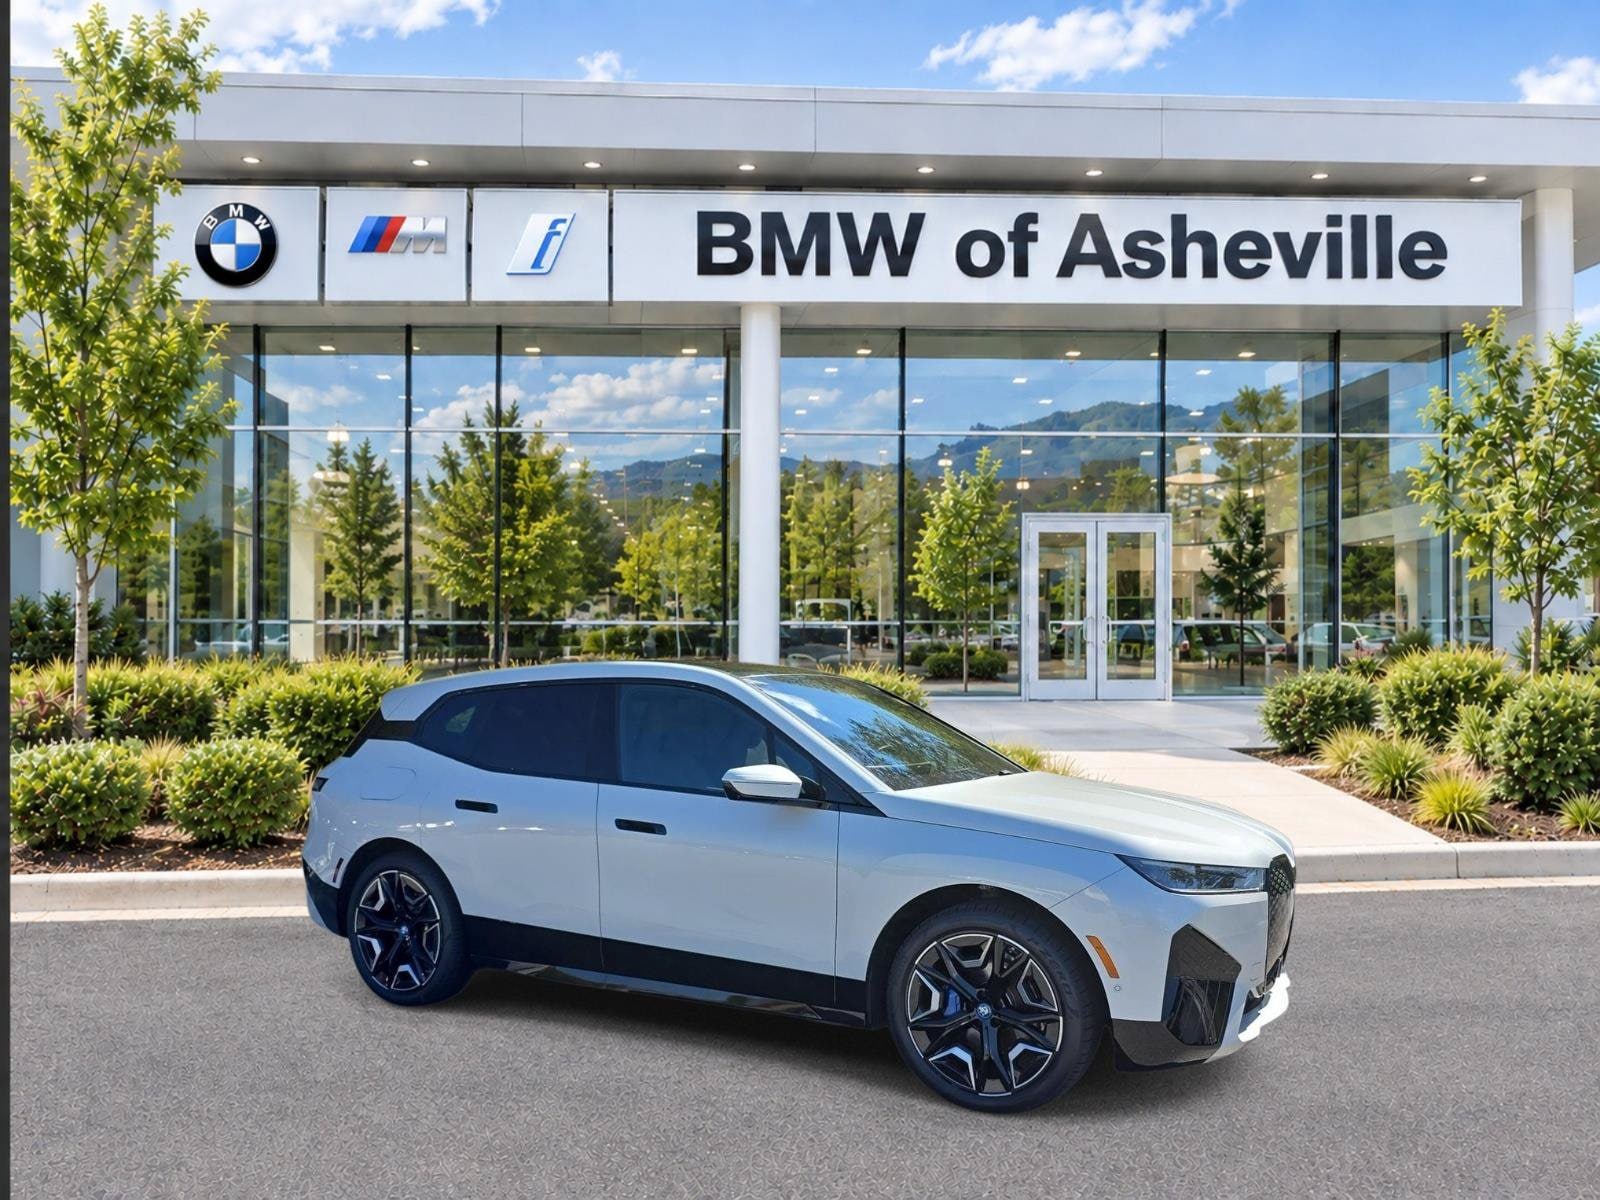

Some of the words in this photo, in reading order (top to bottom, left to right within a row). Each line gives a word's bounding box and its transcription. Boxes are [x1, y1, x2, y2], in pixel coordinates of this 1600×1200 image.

[203, 204, 270, 230] BMW
[390, 216, 447, 253] M
[697, 211, 926, 277] BMW
[955, 212, 1039, 279] of
[1056, 213, 1448, 280] Asheville
